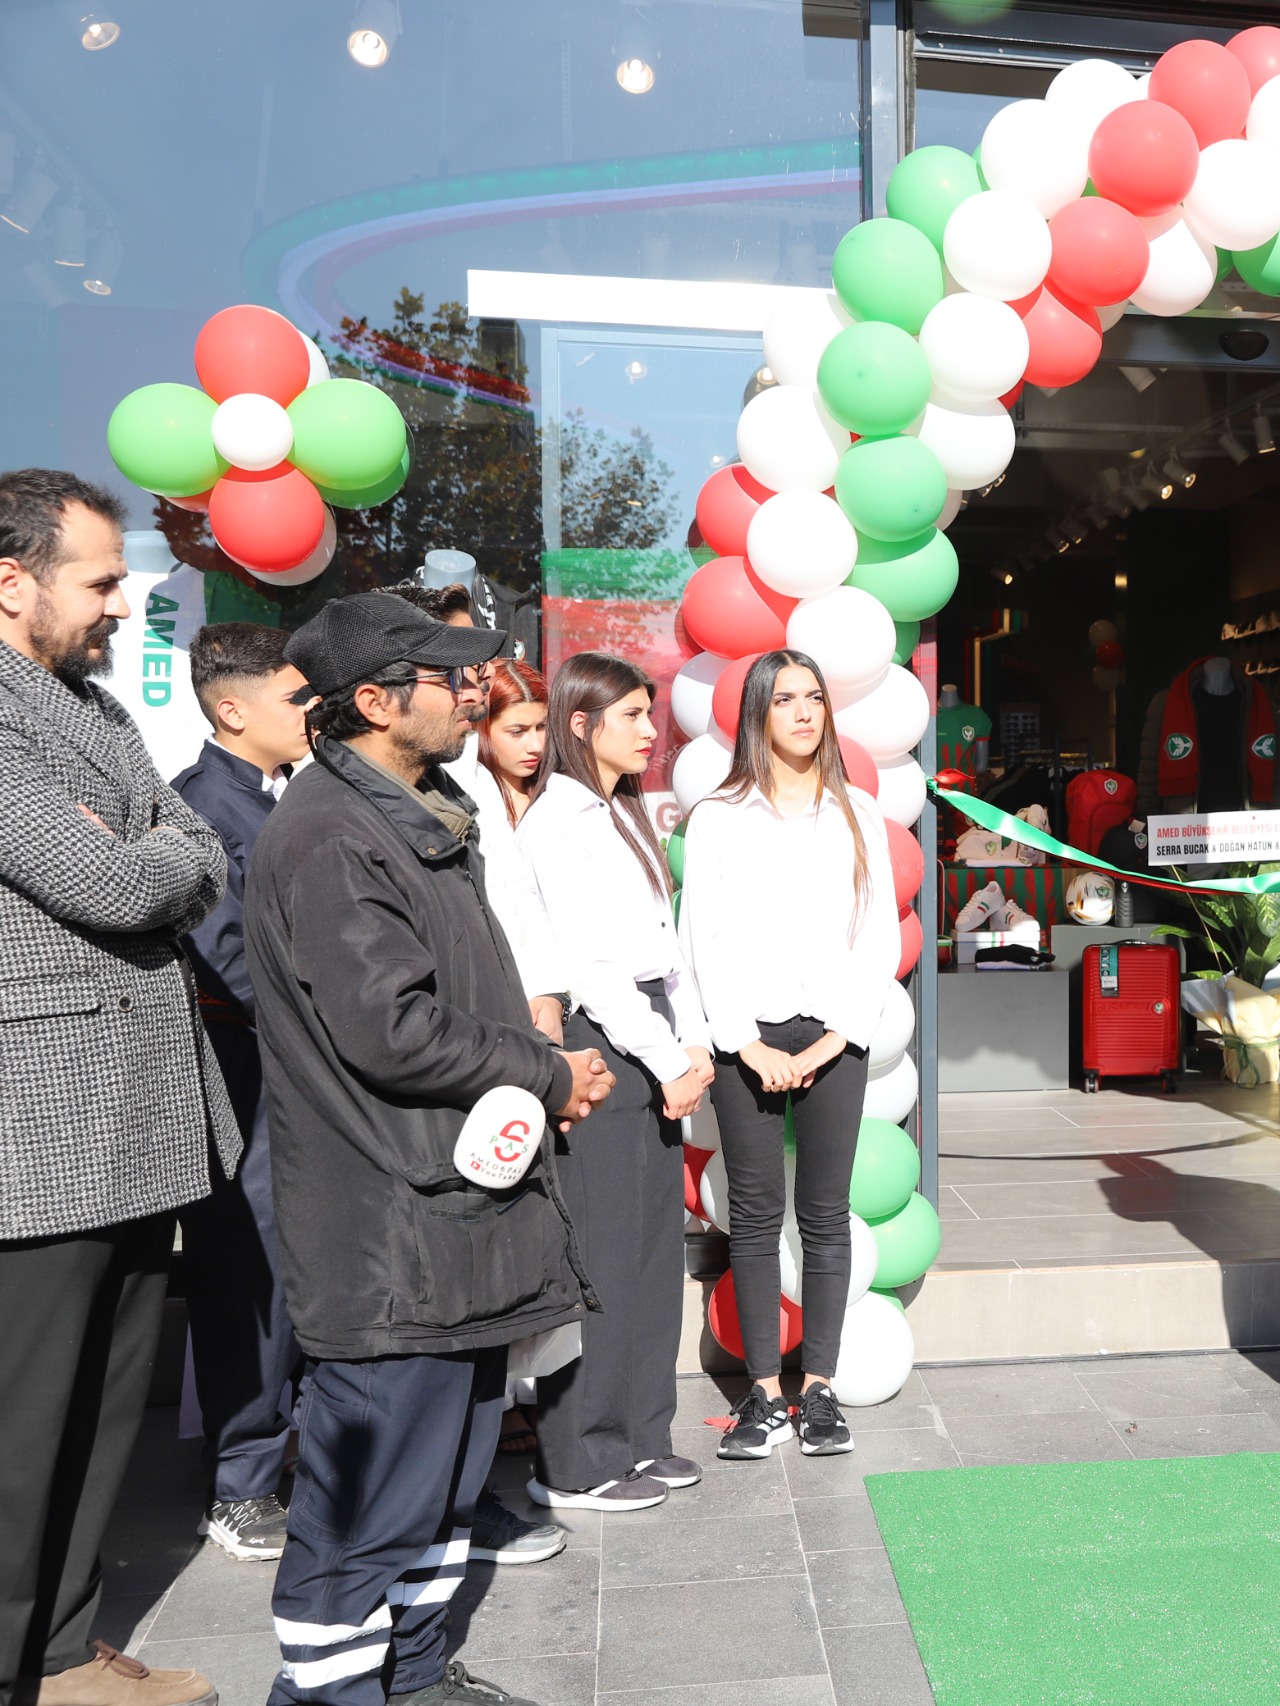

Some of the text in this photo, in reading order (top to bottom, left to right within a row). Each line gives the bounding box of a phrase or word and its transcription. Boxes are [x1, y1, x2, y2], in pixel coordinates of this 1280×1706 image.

[142, 592, 180, 707] AMED
[1157, 827, 1180, 838] AMED
[1156, 845, 1182, 856] SERRA
[1183, 844, 1209, 855] BUCAK
[1219, 840, 1245, 853] DOĞAN
[1248, 841, 1272, 851] HATUN
